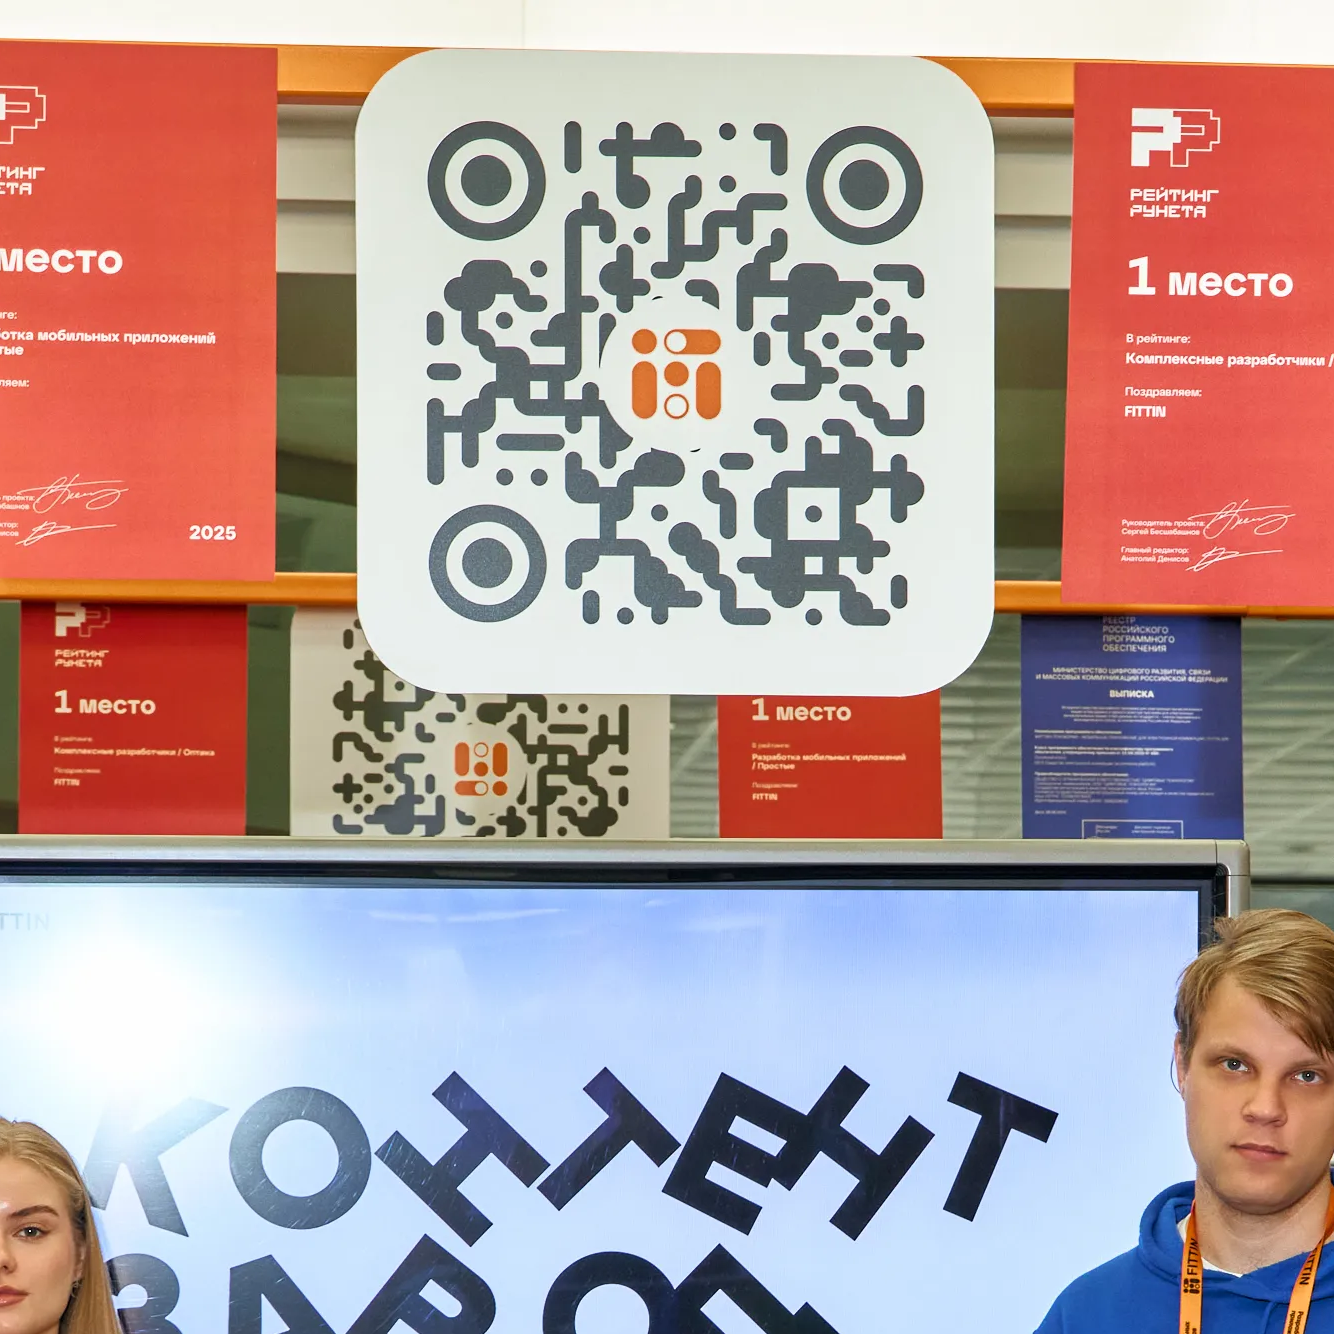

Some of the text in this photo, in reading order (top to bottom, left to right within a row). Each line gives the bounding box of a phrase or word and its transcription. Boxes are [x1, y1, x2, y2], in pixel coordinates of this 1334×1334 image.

[1128, 255, 1293, 297] 1 место
[37, 329, 119, 342] мобильных
[123, 331, 215, 344] приложений
[1125, 352, 1223, 364] Комплексные
[1227, 353, 1325, 367] разработчики
[1124, 405, 1165, 417] FITTIN
[189, 524, 236, 540] 2025
[54, 689, 156, 714] 1 место
[1109, 689, 1155, 699] ВЫПИСКА
[751, 697, 851, 721] 1 место
[83, 1066, 1058, 1243] КОНТЕНТ
